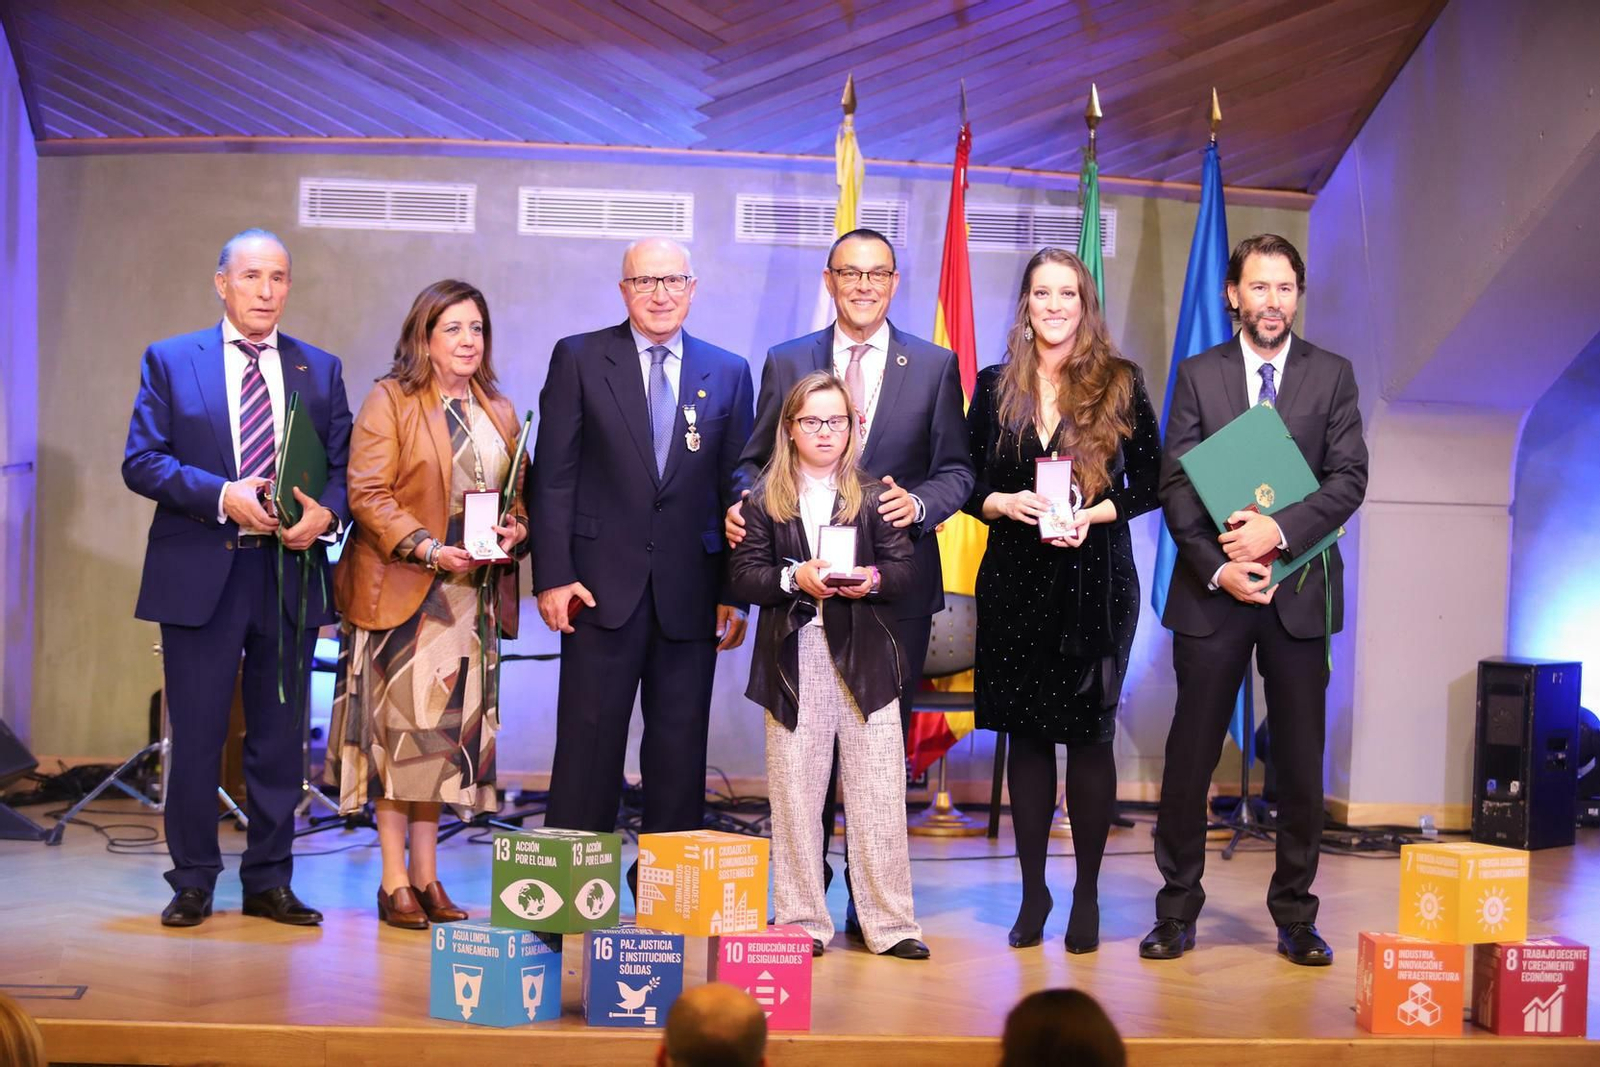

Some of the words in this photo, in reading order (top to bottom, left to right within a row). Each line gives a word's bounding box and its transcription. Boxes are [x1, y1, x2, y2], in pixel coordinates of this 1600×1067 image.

[494, 838, 511, 861] 13
[515, 841, 540, 853] ACCIÓN
[572, 843, 583, 866] 13
[585, 841, 602, 853] ACCIÓN
[684, 844, 700, 860] 11
[515, 853, 529, 865] POR
[529, 855, 537, 865] EL
[537, 855, 557, 867] CLIMA
[585, 855, 594, 866] POR
[599, 853, 613, 864] CLIMA
[703, 847, 715, 870] 11
[1406, 851, 1413, 872] 7
[1467, 860, 1475, 880] 7
[675, 864, 683, 913] SOSTENIBLES
[682, 865, 692, 920] COMUNIDADES
[692, 866, 700, 904] CIUDADES
[436, 928, 445, 951] 6
[452, 930, 470, 942] AGUA
[470, 932, 490, 944] LIMPIA
[638, 939, 673, 951] JUSTICIA
[452, 942, 457, 952] Y
[457, 943, 499, 958] SANEAMIENTO
[508, 935, 516, 959] 6
[593, 937, 613, 960] 16
[725, 942, 744, 963] 10
[747, 942, 786, 952] REDUCCIÓN
[787, 943, 797, 953] DE
[797, 943, 811, 953] LAS
[1522, 948, 1555, 960] TRABAJO
[1556, 949, 1588, 960] DECENTE
[619, 951, 625, 962] E
[625, 952, 682, 964] INSTITUCIONES
[747, 954, 803, 965] DESIGUALDADES
[1383, 948, 1395, 970] 9
[1398, 960, 1439, 970] INNOVACIÓN
[1439, 960, 1444, 970] E
[1506, 948, 1518, 971] 8
[1522, 960, 1527, 971] Y
[1527, 960, 1575, 971] CRECIMIENTO
[619, 962, 652, 975] SÓLIDAS
[1397, 970, 1460, 982] INFRAESTRUCTURA
[1521, 971, 1564, 983] ECONÓMICO
